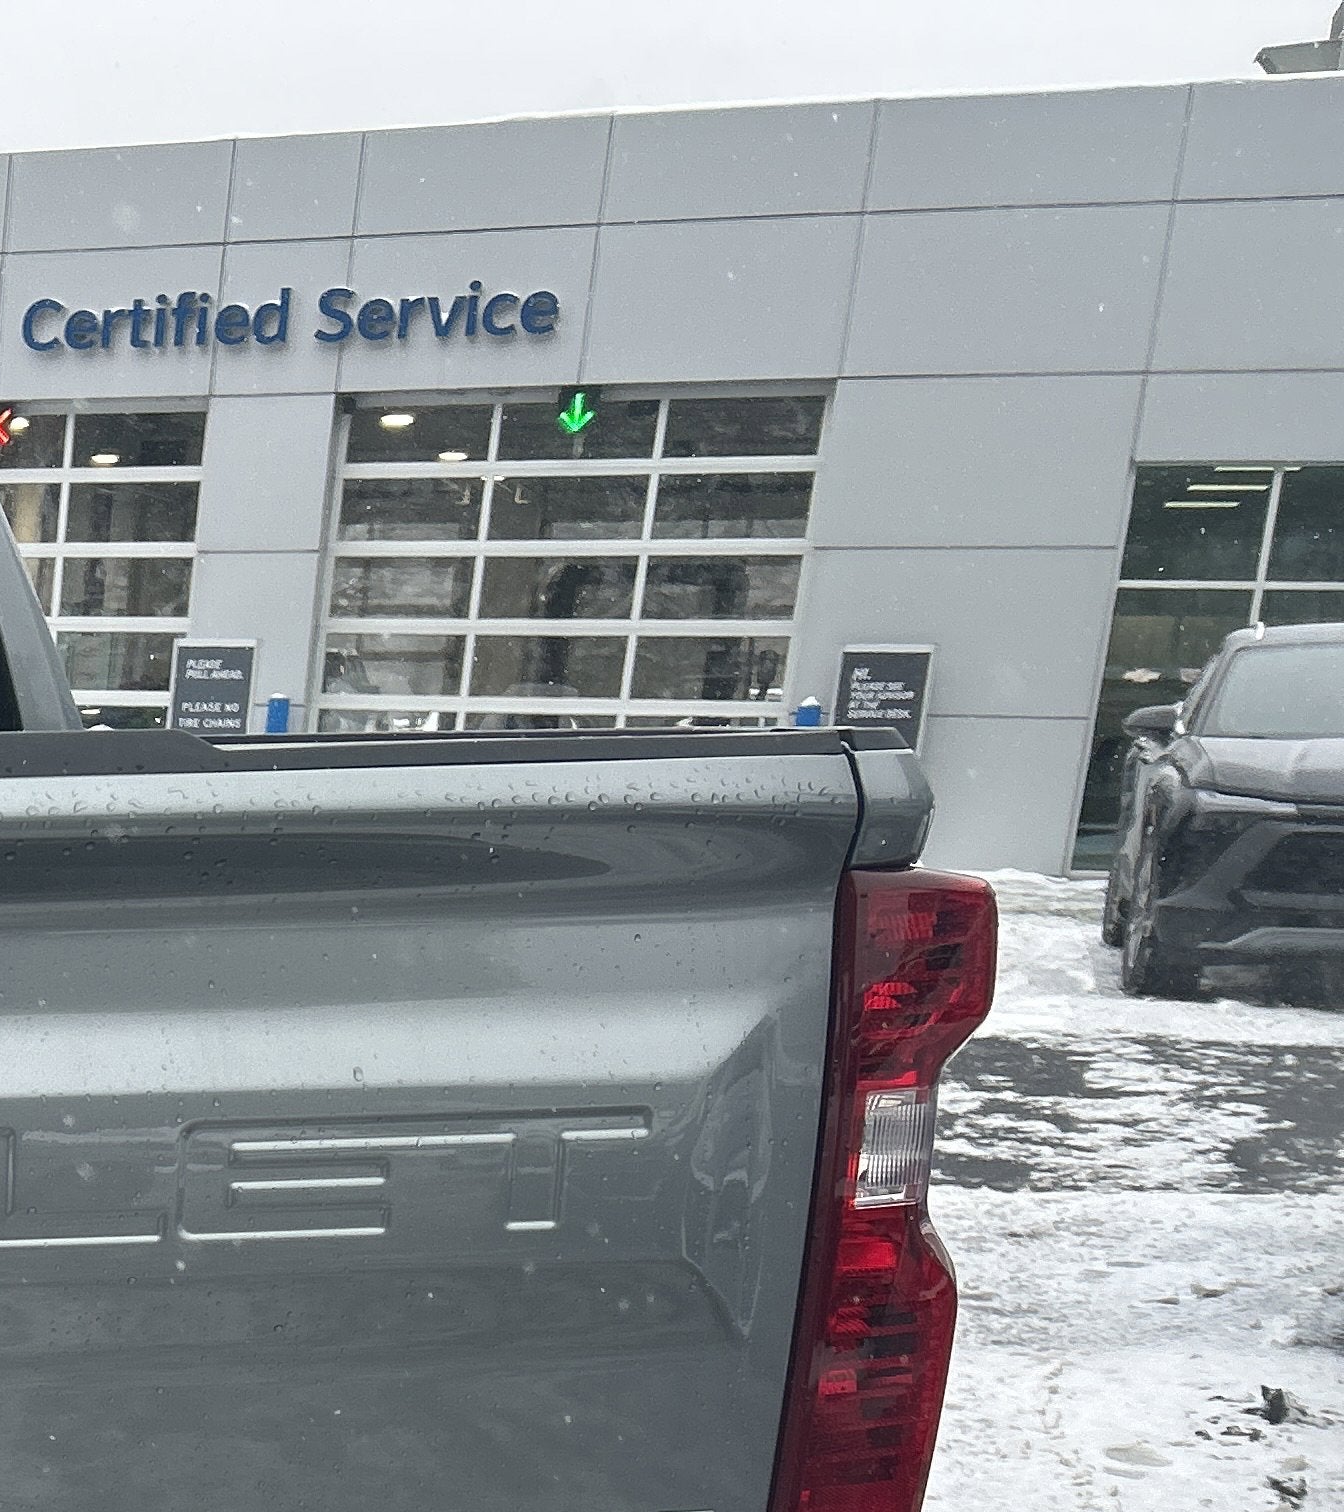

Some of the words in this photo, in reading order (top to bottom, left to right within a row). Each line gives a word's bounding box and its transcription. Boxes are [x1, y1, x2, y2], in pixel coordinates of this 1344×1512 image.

[21, 287, 292, 351] Certified
[314, 279, 560, 343] Service
[181, 702, 223, 713] PLEASE
[224, 702, 240, 713] NO
